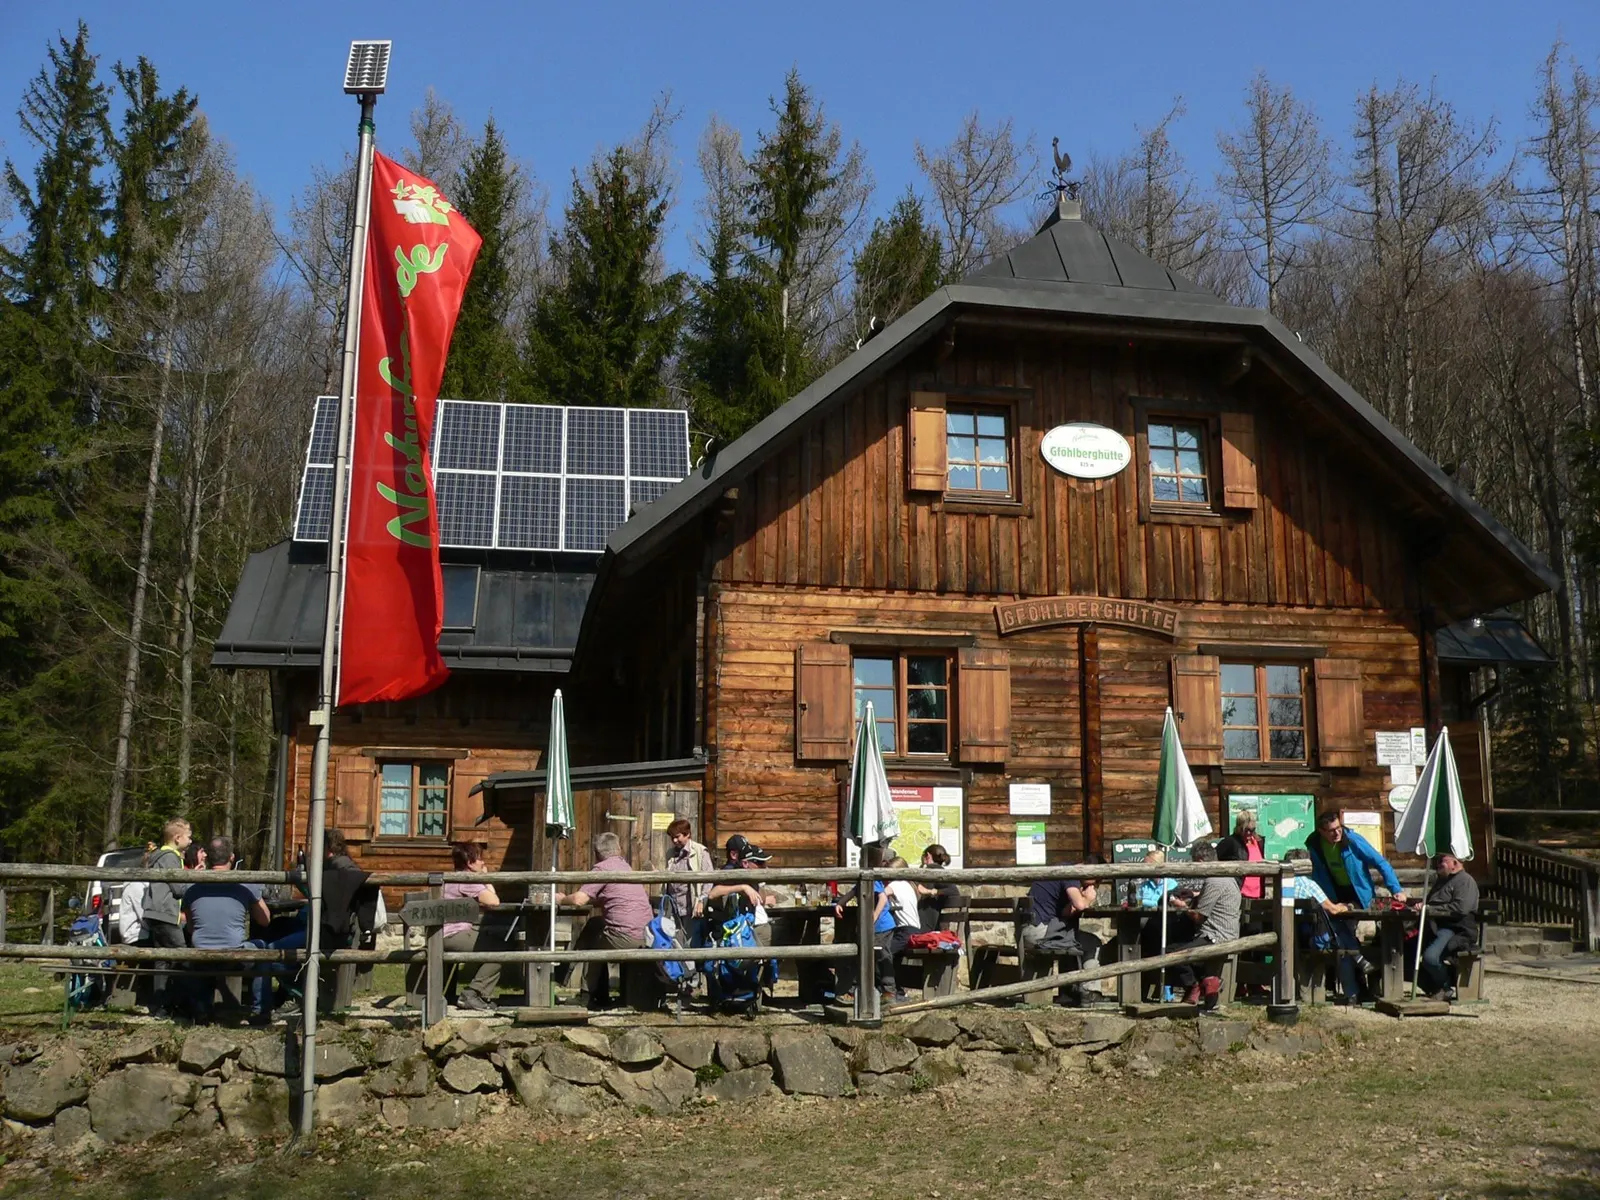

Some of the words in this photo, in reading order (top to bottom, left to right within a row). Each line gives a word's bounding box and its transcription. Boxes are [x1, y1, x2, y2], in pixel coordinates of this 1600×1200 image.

[376, 242, 449, 549] Naturfde
[1050, 446, 1123, 461] Gföhlberghütte
[1004, 602, 1174, 629] GFÖHLBERGHÜTTE
[412, 902, 470, 920] RAXBLICK
